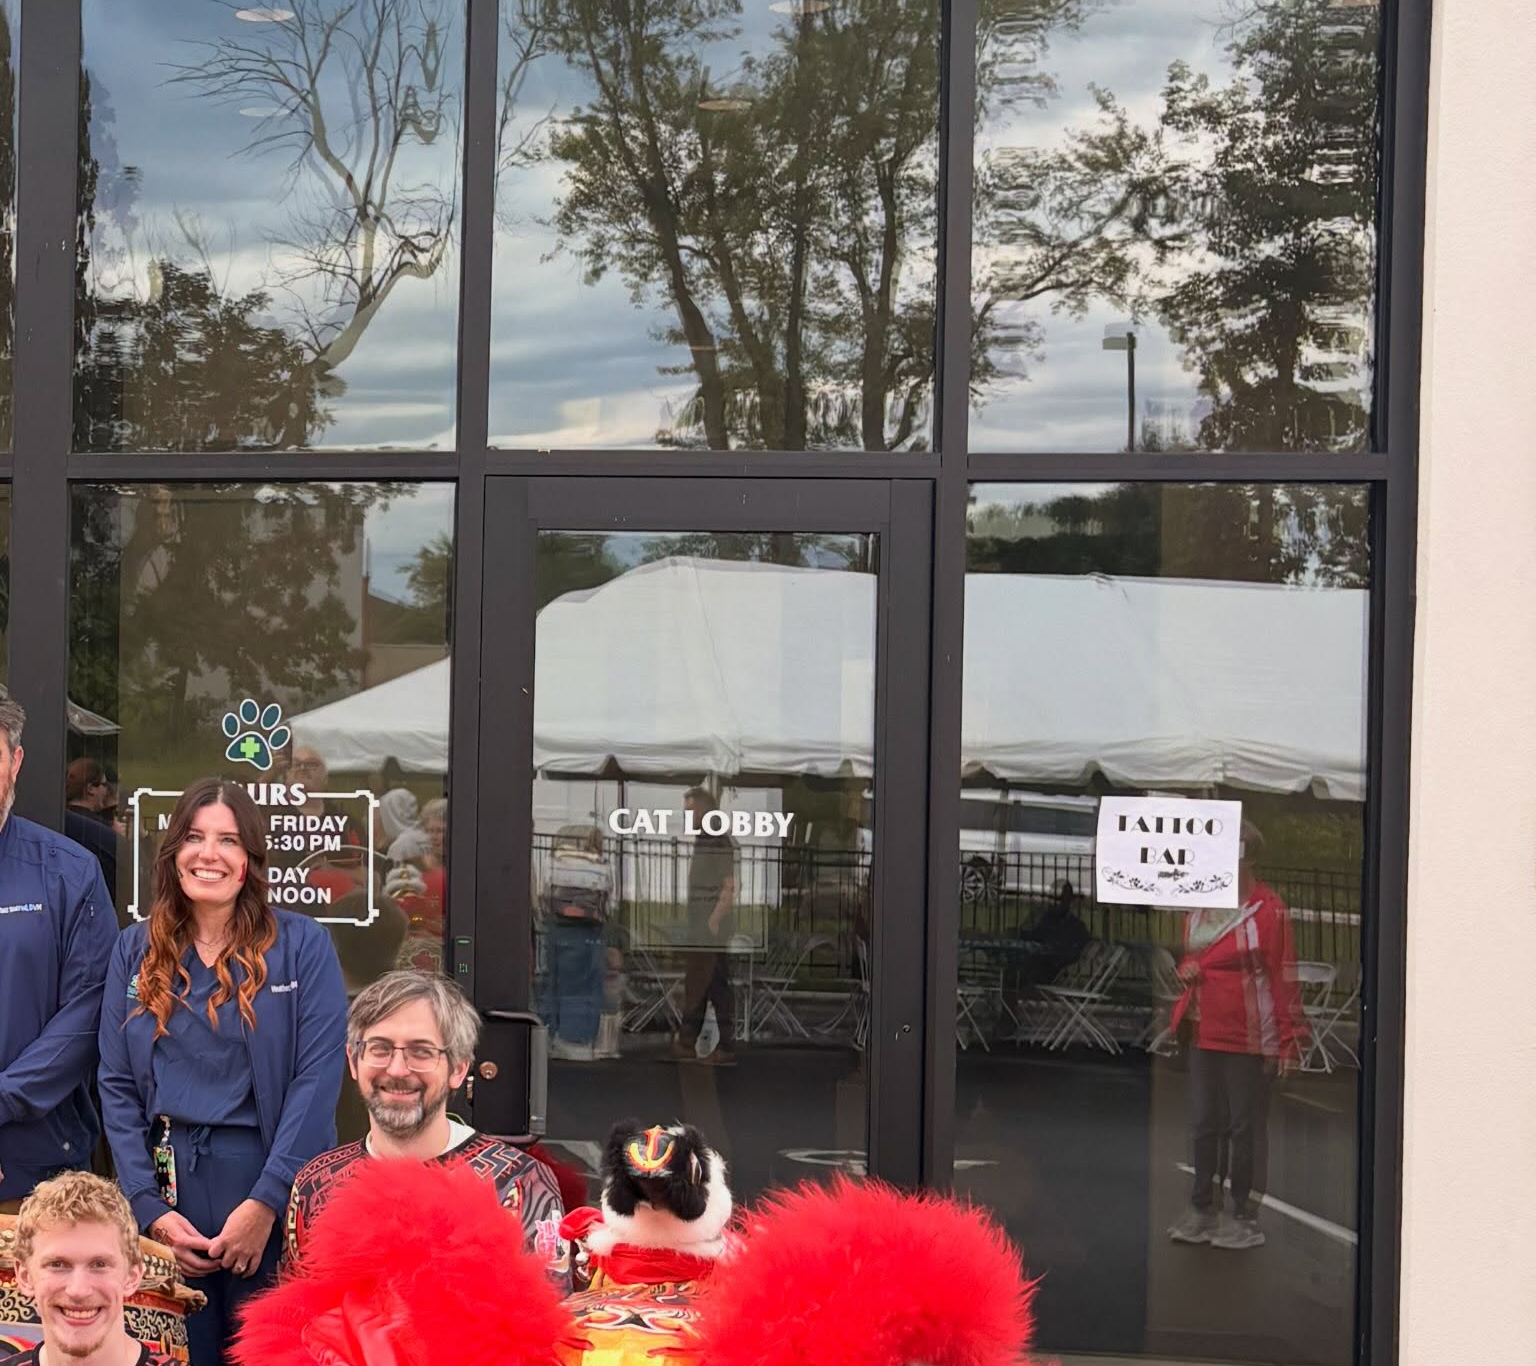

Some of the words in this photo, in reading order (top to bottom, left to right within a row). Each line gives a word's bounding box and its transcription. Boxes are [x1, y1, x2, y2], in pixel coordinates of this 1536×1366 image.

[246, 783, 307, 806] URS
[270, 815, 348, 832] FRIDAY
[609, 808, 673, 835] CAT
[684, 809, 795, 838] LOBBY
[1115, 814, 1224, 836] TATTOO
[309, 835, 341, 852] PM
[1140, 846, 1196, 867] BAR
[267, 888, 331, 905] NOON
